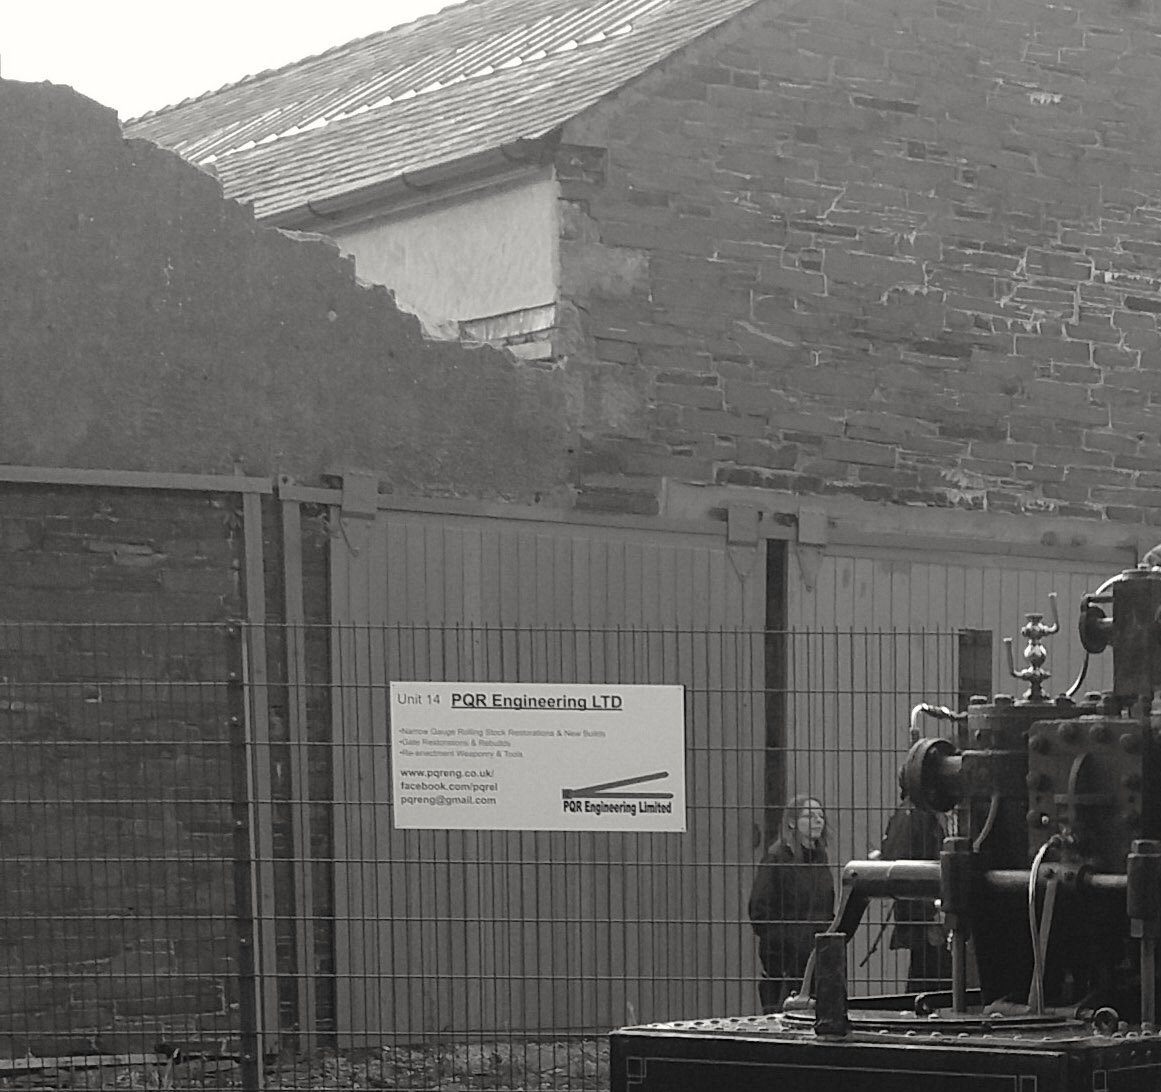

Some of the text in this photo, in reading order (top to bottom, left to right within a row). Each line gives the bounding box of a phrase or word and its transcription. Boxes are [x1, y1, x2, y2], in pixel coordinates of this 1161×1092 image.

[397, 693, 622, 711] Unit 14 PQR Engineering LTD
[400, 769, 494, 779] www.pqreng.co.uk/
[401, 795, 496, 806] pqreng@gmail.com
[563, 801, 672, 816] PQR Engineering Limited
